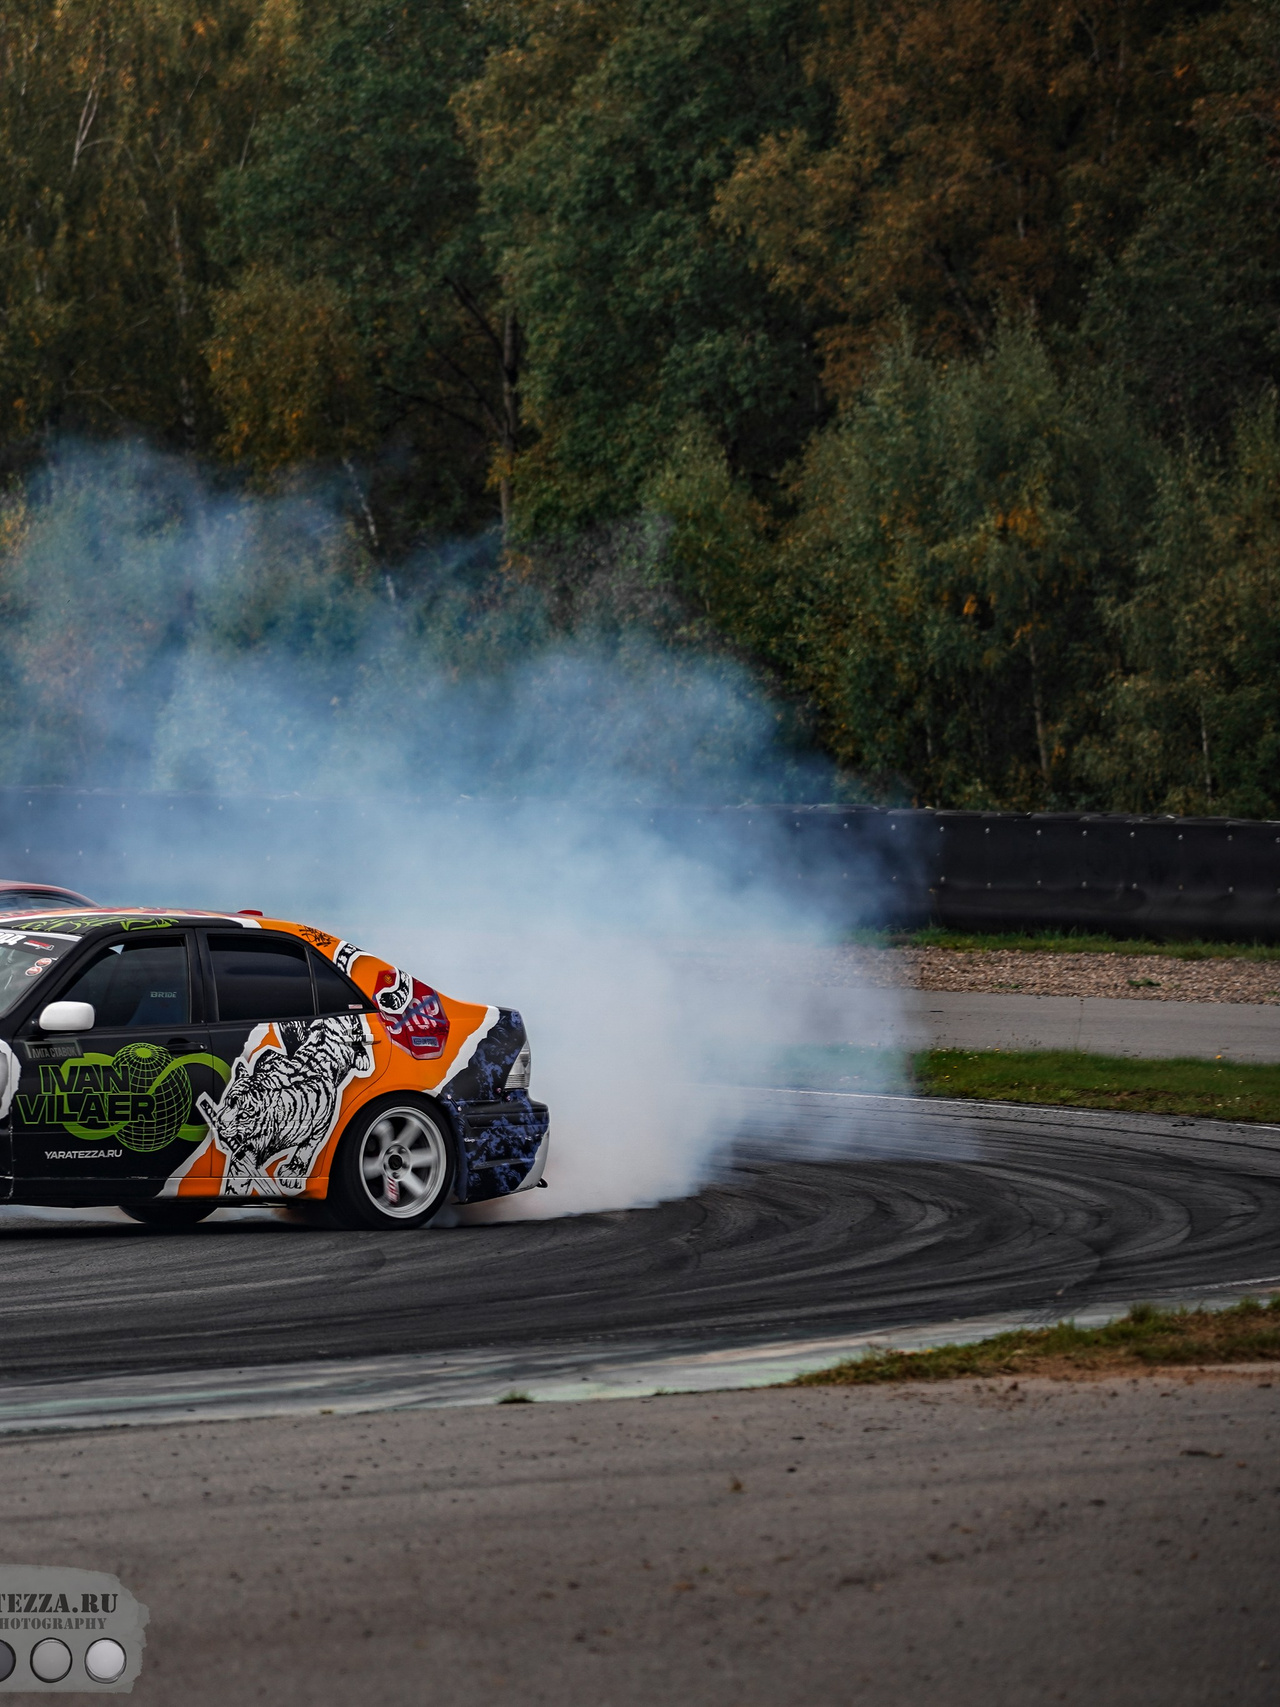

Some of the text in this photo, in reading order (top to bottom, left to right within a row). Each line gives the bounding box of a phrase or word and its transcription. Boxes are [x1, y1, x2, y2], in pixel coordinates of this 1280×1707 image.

[150, 991, 177, 999] BRIDE
[31, 1046, 78, 1059] ЛИГА СТАВОК
[39, 1065, 130, 1095] IVAN
[16, 1093, 157, 1124] VILAER
[44, 1149, 123, 1160] YARATEZZA.RU
